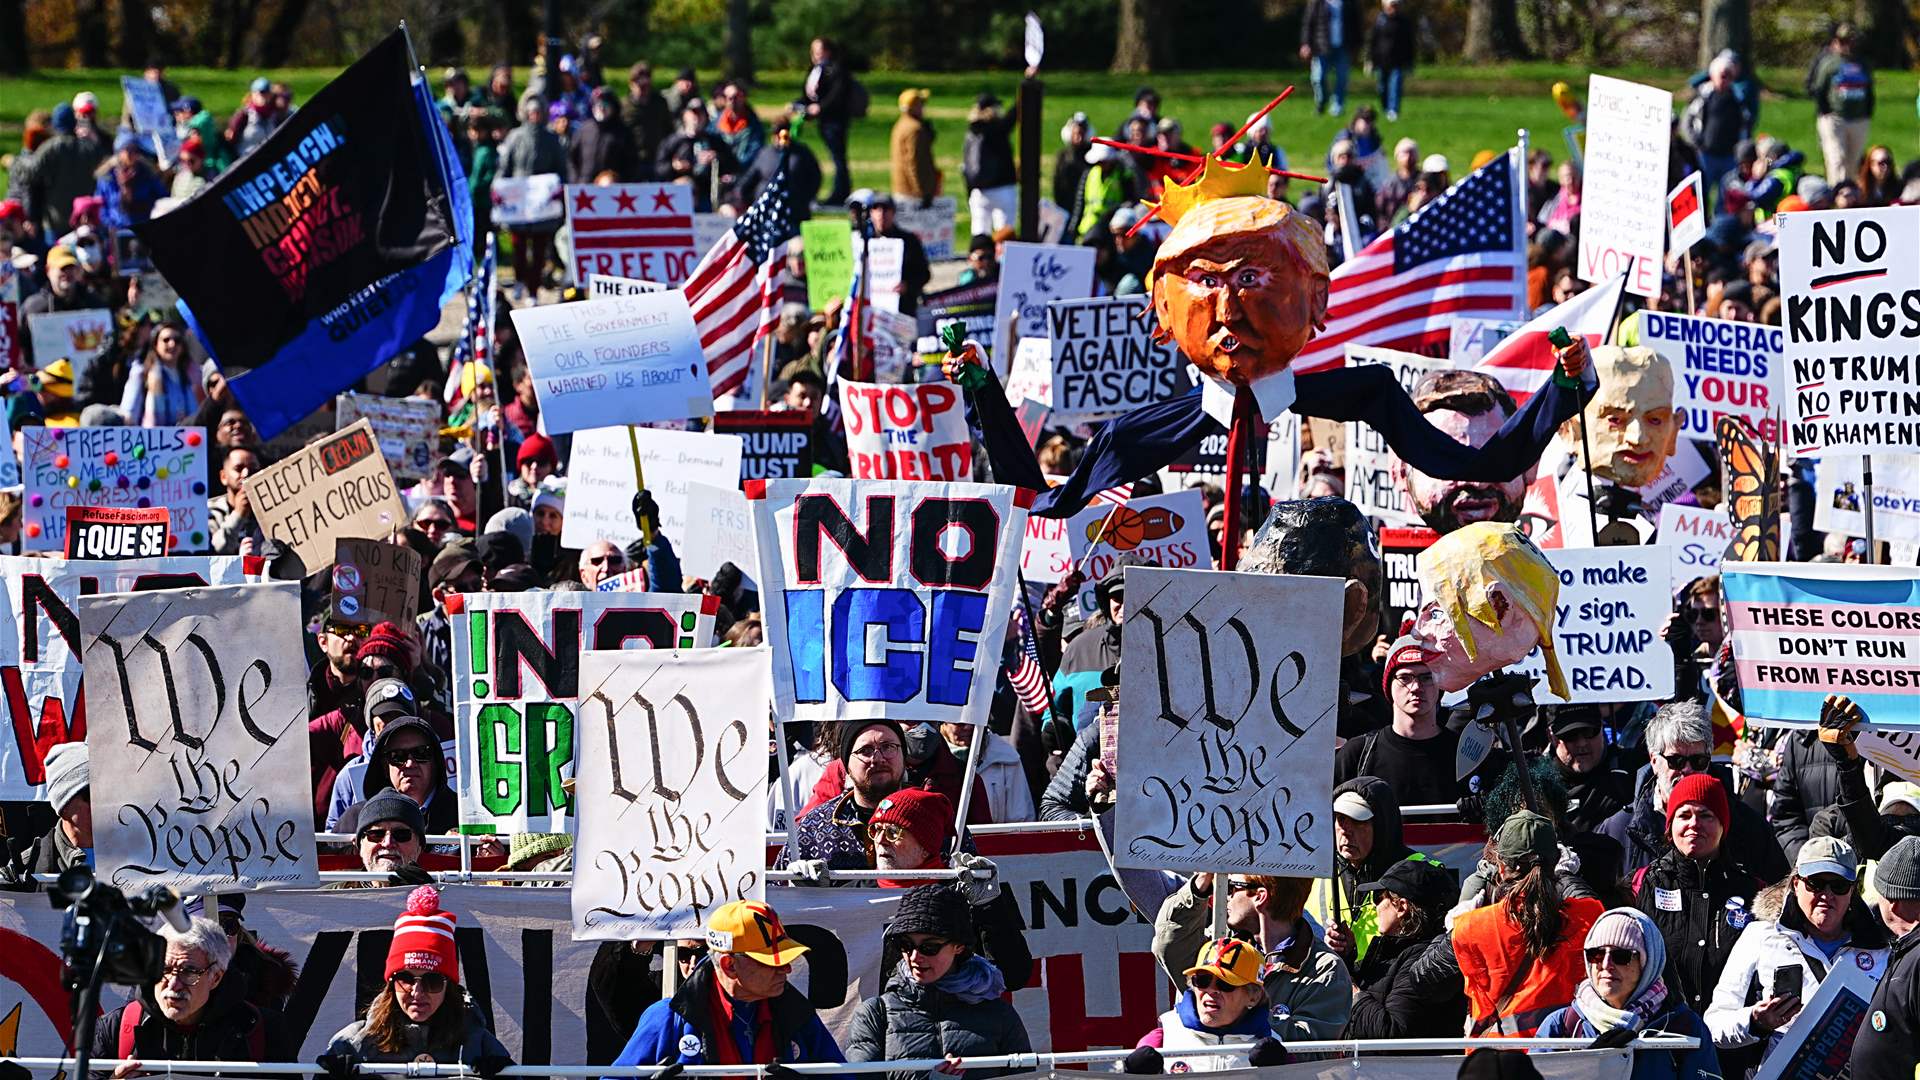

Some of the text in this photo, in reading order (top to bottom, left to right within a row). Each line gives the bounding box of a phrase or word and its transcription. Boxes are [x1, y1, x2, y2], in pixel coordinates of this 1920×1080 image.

[1812, 219, 1887, 268] NO
[577, 251, 698, 283] FREE DC
[594, 279, 623, 296] THE
[537, 312, 670, 342] THE GOVERNMENT
[1647, 313, 1784, 353] DEMOCRAC
[554, 341, 671, 371] OUR FOUNDERS
[1685, 344, 1768, 379] NEEDS
[1793, 357, 1826, 385] NO
[549, 373, 608, 396] WARNED
[616, 371, 635, 387] US
[1684, 374, 1770, 410] YOUR
[846, 384, 957, 436] STOP
[1798, 391, 1830, 418] NO
[65, 429, 186, 458] FREE BALLS
[736, 432, 808, 455] RUMP
[883, 429, 918, 445] THE
[1792, 423, 1818, 447] NO
[36, 453, 196, 487] FOR MEMBERS OF
[253, 457, 308, 513] ELECT
[309, 452, 326, 482] A
[320, 436, 371, 476] CLOWN
[678, 452, 725, 468] Demand
[742, 457, 799, 479] UST
[50, 482, 140, 509] CONGRESS
[312, 501, 330, 534] A
[325, 471, 392, 521] CIRCUS
[82, 508, 160, 521] RefuseFascism.org
[139, 525, 165, 557] SE
[793, 493, 1001, 592] NO
[1556, 560, 1648, 586] o make
[1579, 597, 1636, 626] sign.
[1747, 606, 1825, 627] THESE
[783, 586, 989, 707] ICE
[1559, 629, 1653, 656] TRUMP
[1778, 637, 1907, 659] DON'T RUN
[1127, 587, 1334, 756] We
[1572, 665, 1652, 690] READ.
[1756, 665, 1820, 685] FROM
[87, 609, 304, 766] We
[580, 667, 765, 820] We
[1198, 725, 1272, 794] the
[168, 747, 250, 815] the
[647, 802, 716, 862] the
[1130, 776, 1319, 863] People
[112, 797, 304, 885] People
[585, 848, 757, 928] People
[404, 958, 438, 967] DEMAND
